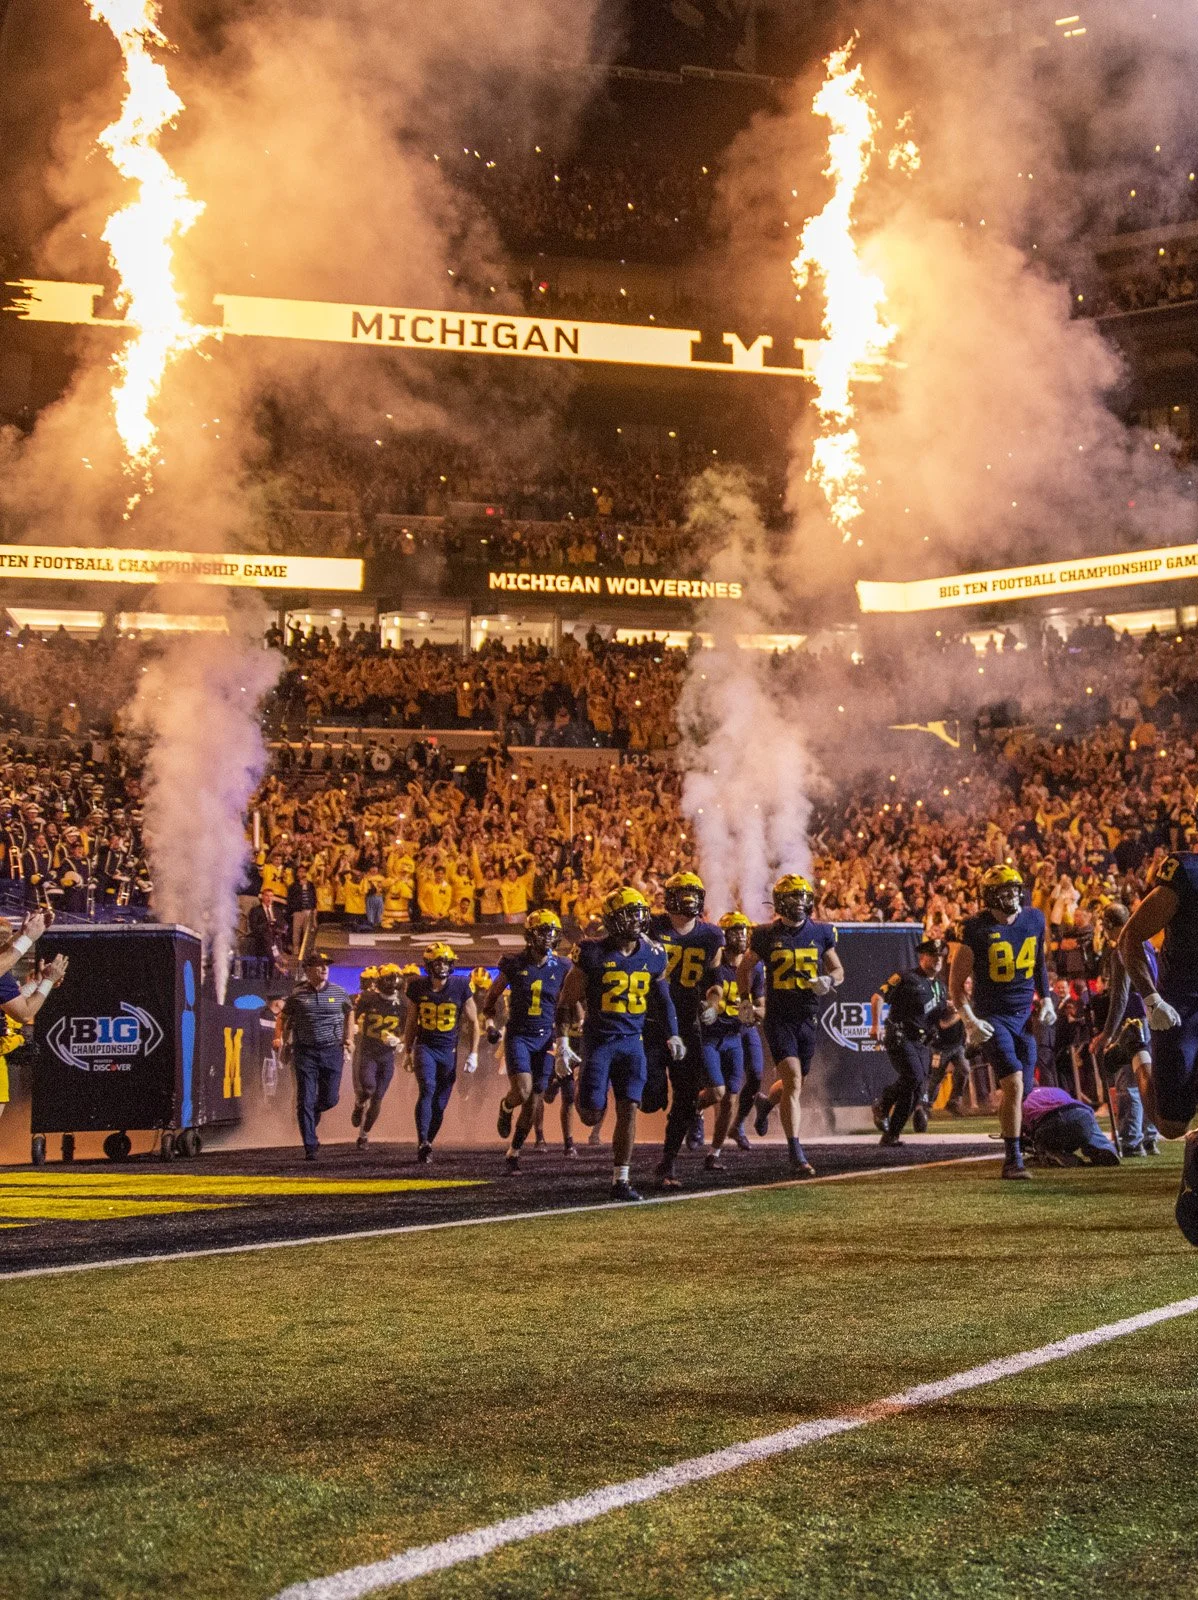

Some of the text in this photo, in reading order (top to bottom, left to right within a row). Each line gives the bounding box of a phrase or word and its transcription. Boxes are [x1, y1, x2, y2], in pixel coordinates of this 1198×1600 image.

[351, 311, 580, 354] MICHIGAN
[0, 554, 288, 578] TEN FOOTBALL CHAMPIONSHIP GAME
[939, 586, 960, 598] BIG
[964, 581, 988, 595] TEN
[992, 572, 1056, 591] FOOTBALL
[1060, 560, 1162, 583] CHAMPIONSHIP
[489, 572, 742, 599] MICHIGAN WOLVERINES
[623, 754, 650, 767] 132
[663, 944, 705, 988] 76
[771, 948, 819, 990] 25
[989, 936, 1037, 982] 84
[528, 980, 543, 1015] 1
[602, 971, 651, 1014] 28
[368, 1014, 400, 1038] 22
[419, 1002, 457, 1032] 88
[71, 1045, 138, 1054] CHAMPIONSHIP
